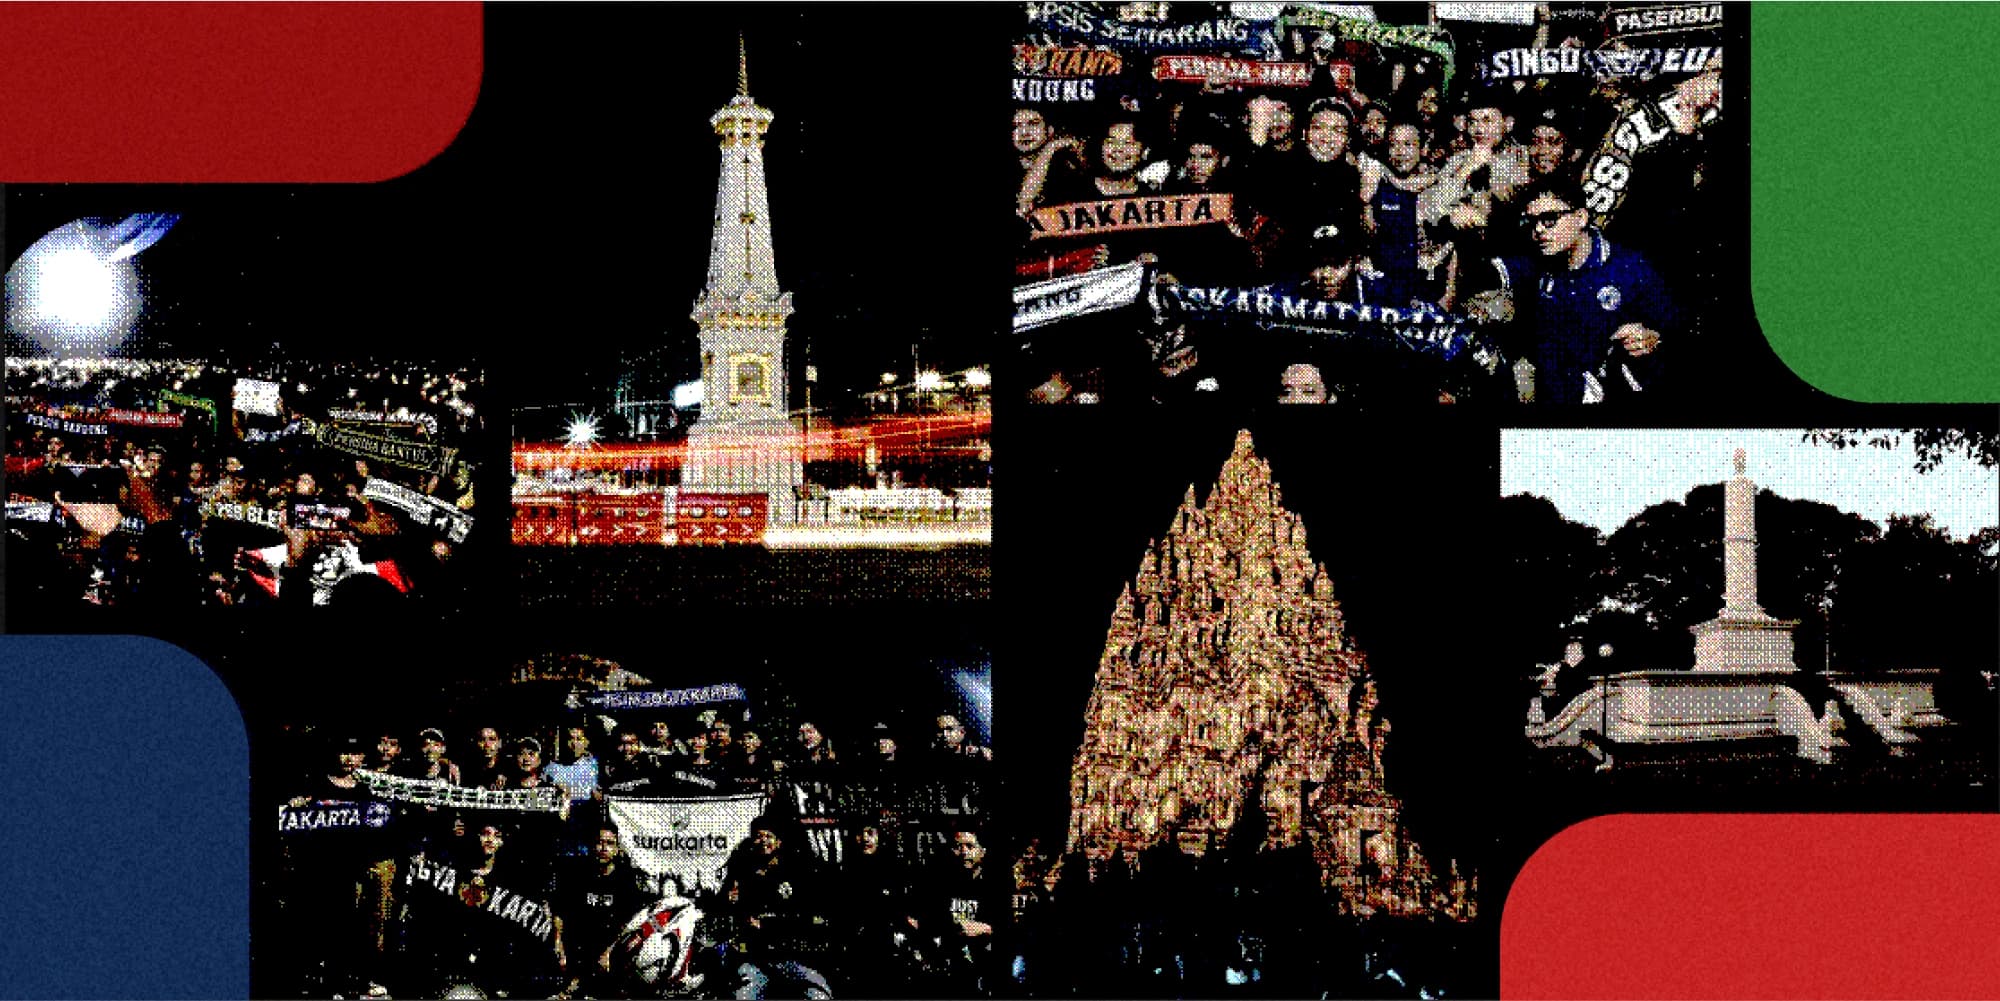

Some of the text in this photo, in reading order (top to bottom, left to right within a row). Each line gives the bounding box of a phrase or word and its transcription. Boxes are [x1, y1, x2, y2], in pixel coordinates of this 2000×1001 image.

[1099, 18, 1250, 45] SEMARANG
[1491, 47, 1580, 79] SINGO
[1056, 197, 1213, 232] JAKARTA
[632, 832, 728, 851] surakarta
